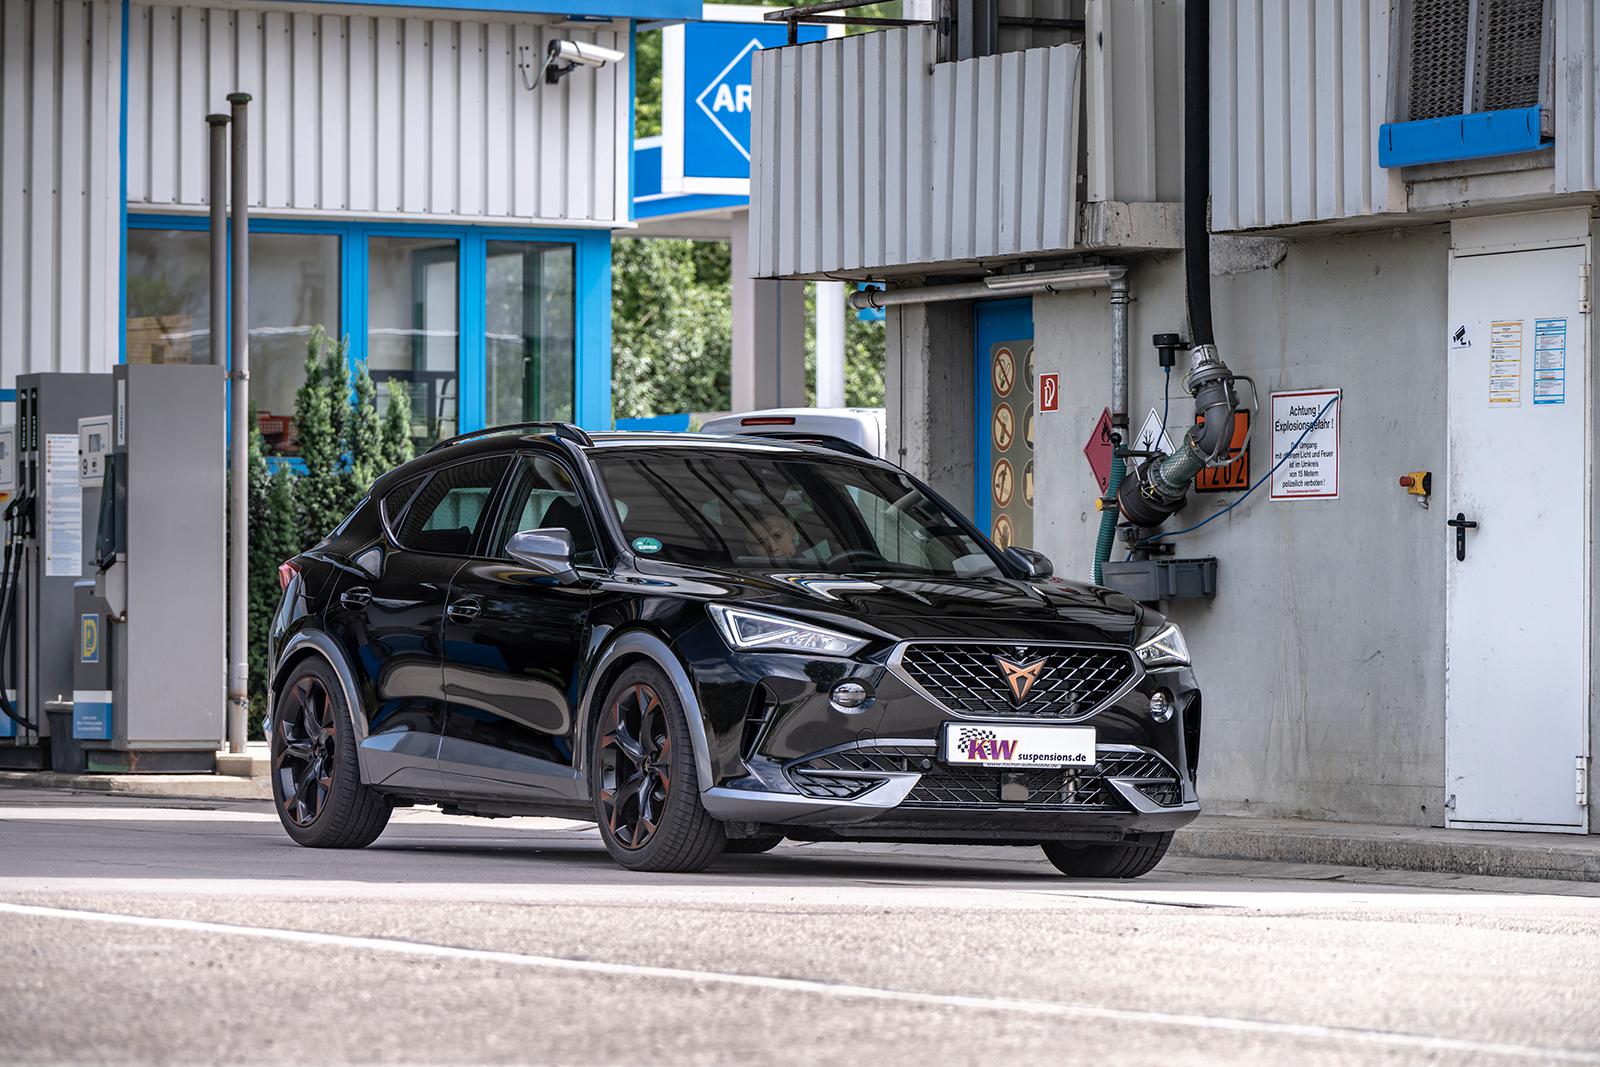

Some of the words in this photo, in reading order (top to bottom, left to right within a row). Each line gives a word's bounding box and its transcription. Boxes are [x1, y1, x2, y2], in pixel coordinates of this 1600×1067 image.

[1290, 405, 1316, 417] Achtung
[1312, 450, 1320, 458] und
[967, 738, 1018, 761] KW
[1018, 752, 1087, 763] suspensions.de
